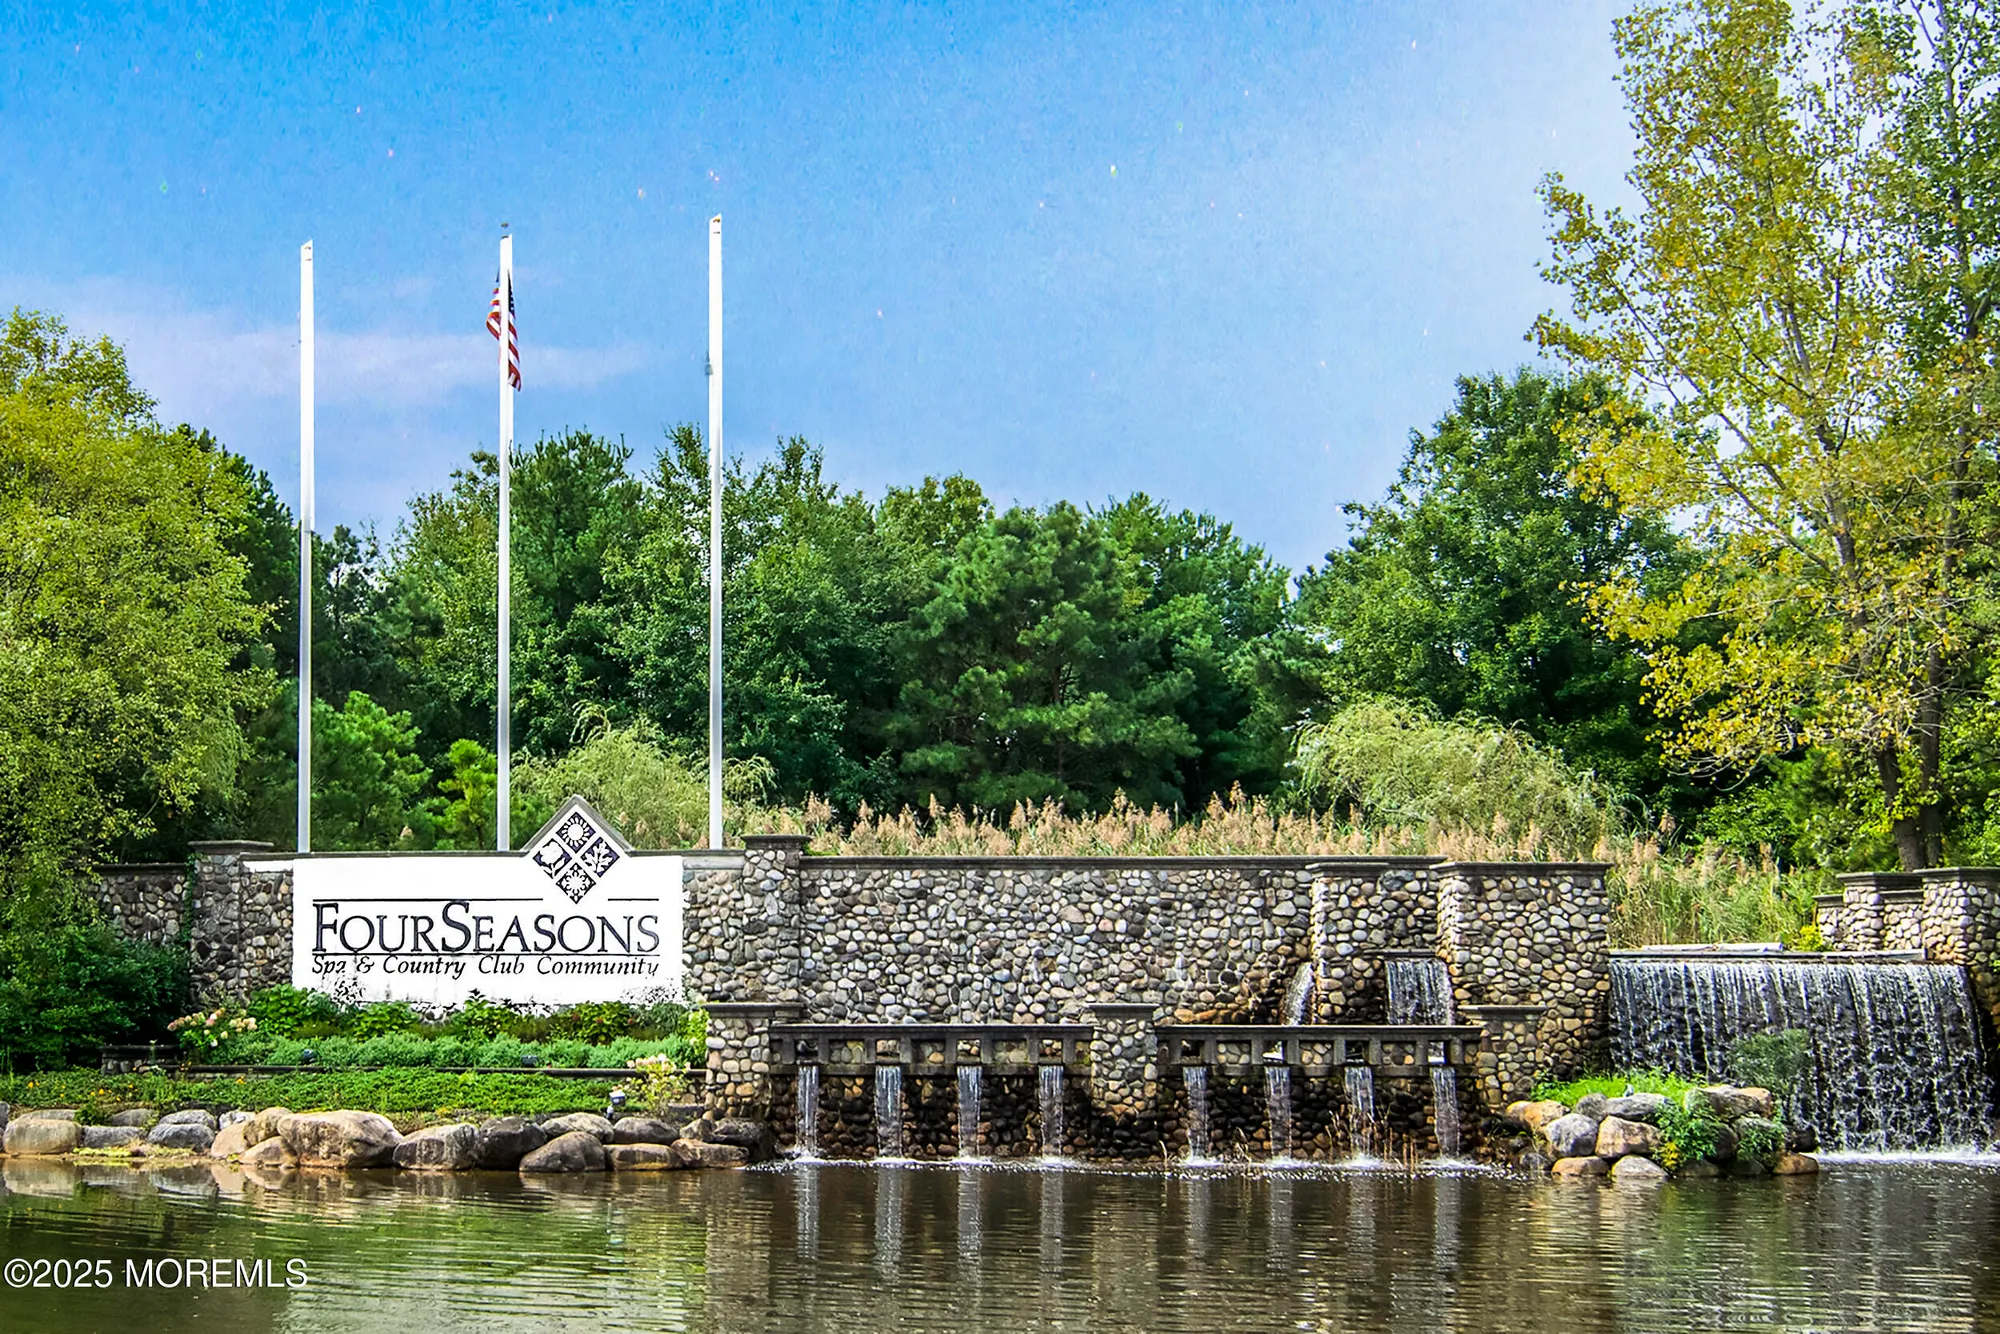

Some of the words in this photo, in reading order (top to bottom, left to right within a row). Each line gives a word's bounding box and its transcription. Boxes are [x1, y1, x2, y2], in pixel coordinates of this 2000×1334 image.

[356, 956, 375, 974] &
[383, 955, 466, 980] Country
[478, 955, 525, 975] Club
[537, 956, 659, 976] Community
